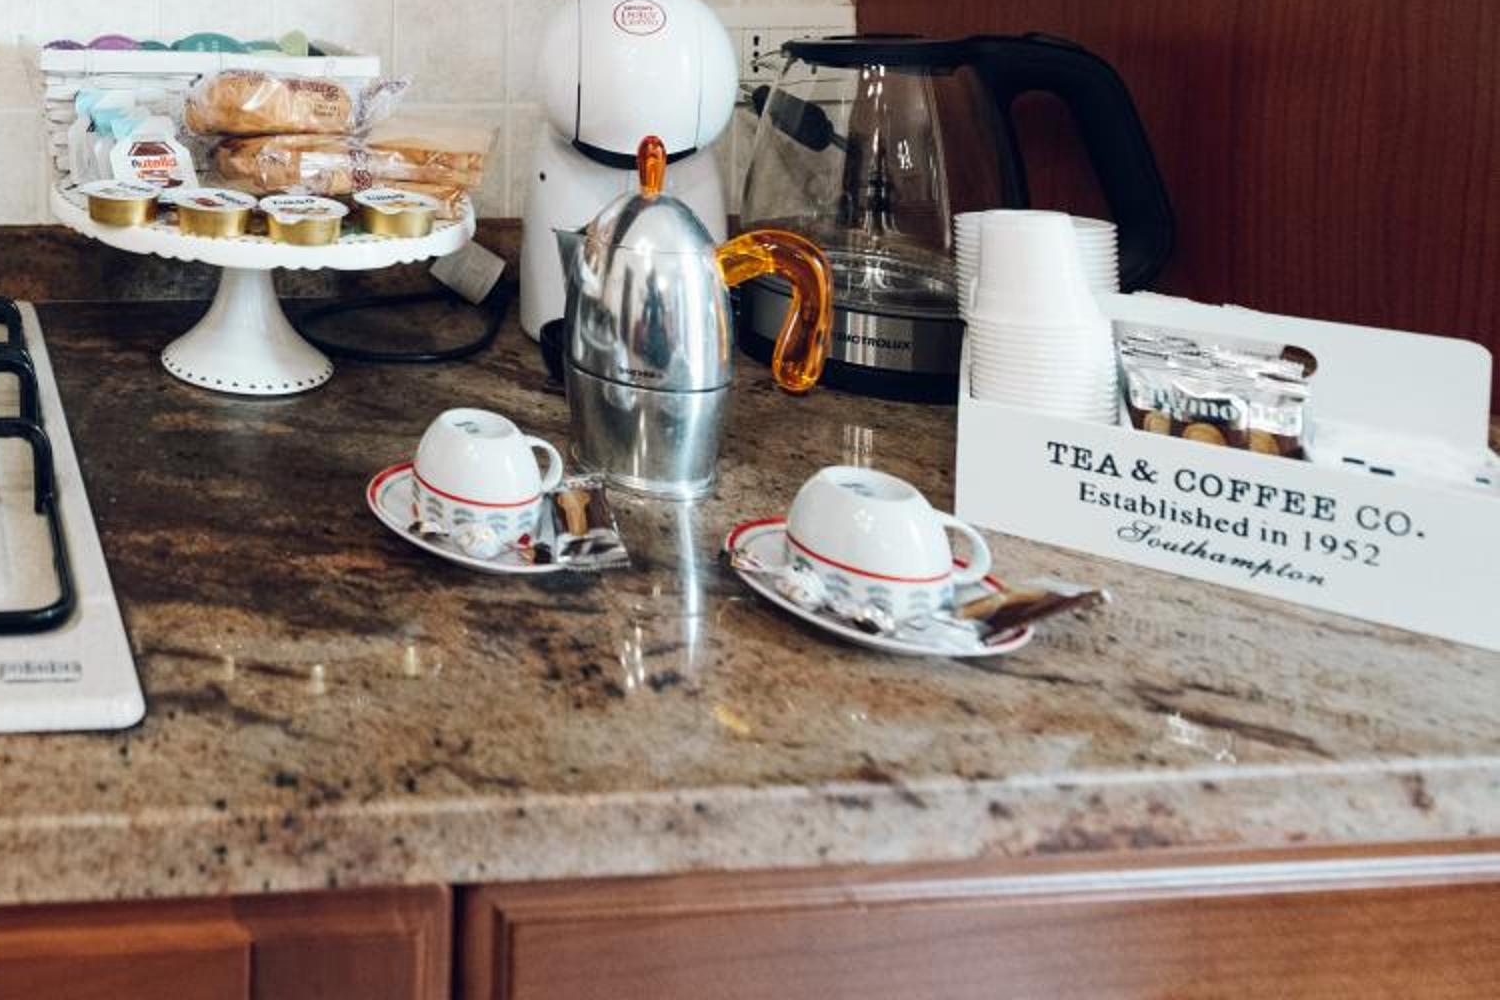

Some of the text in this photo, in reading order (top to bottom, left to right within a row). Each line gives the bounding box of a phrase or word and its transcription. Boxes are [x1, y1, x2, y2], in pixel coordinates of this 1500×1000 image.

[1047, 441, 1426, 538] TEA & COFFEE CO.
[1079, 482, 1381, 567] Established in 1952
[1117, 520, 1325, 586] Southampton
